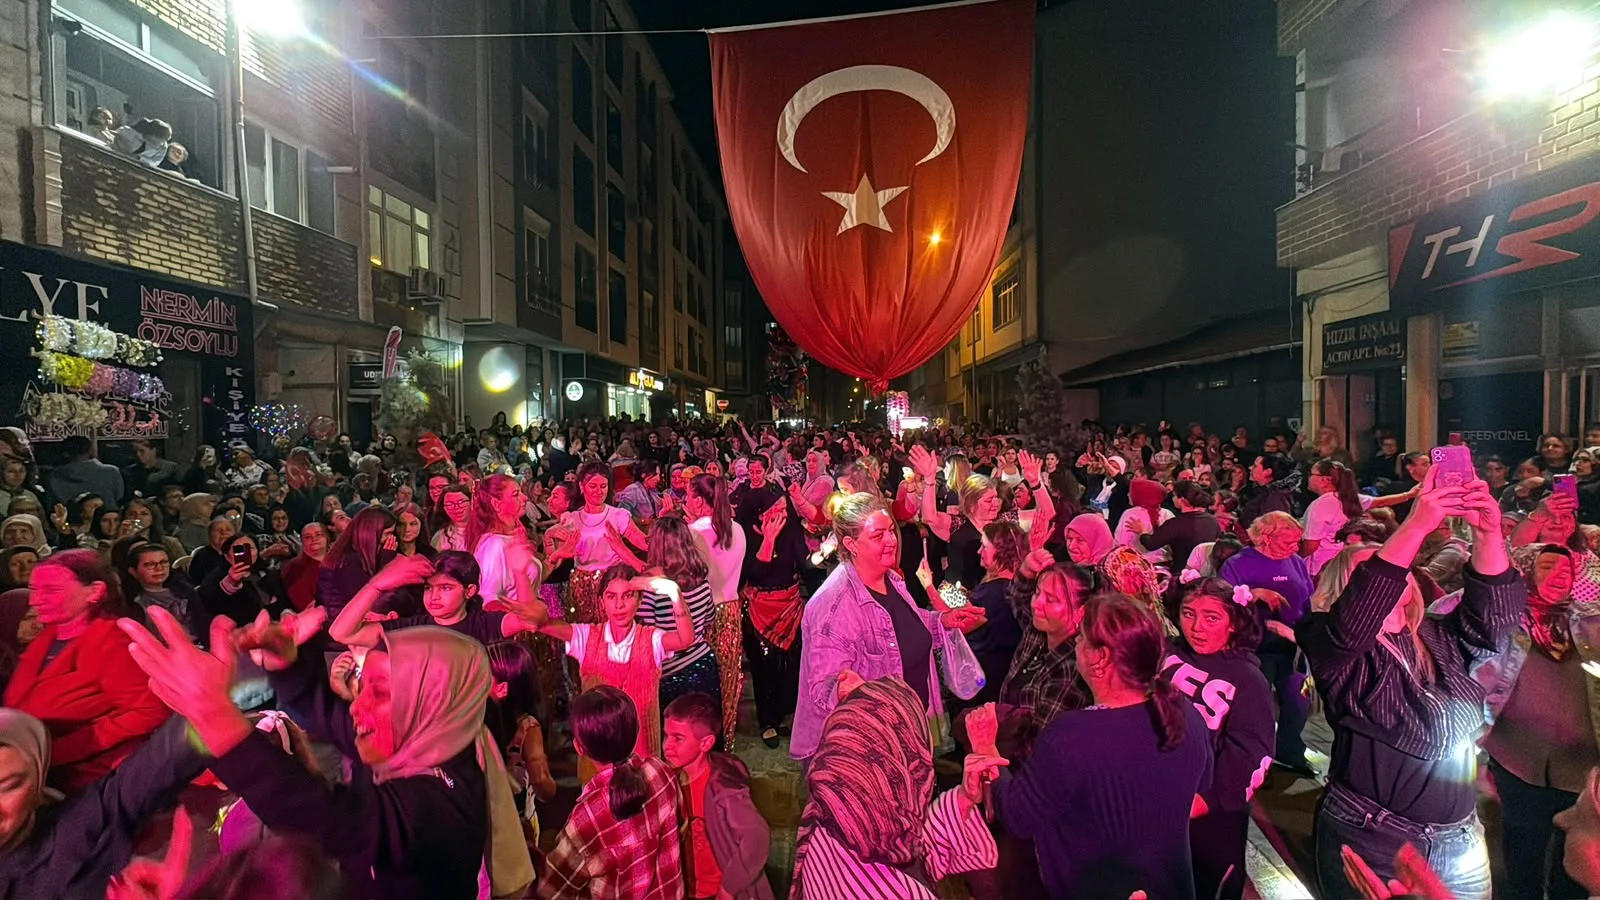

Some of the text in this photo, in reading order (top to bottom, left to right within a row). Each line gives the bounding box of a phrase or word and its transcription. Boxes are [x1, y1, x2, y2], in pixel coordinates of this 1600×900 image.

[140, 285, 238, 329] NERMİN
[137, 317, 239, 358] ÖZSOYLU
[1448, 430, 1532, 441] OFESYONEL
[1162, 654, 1236, 730] ES
